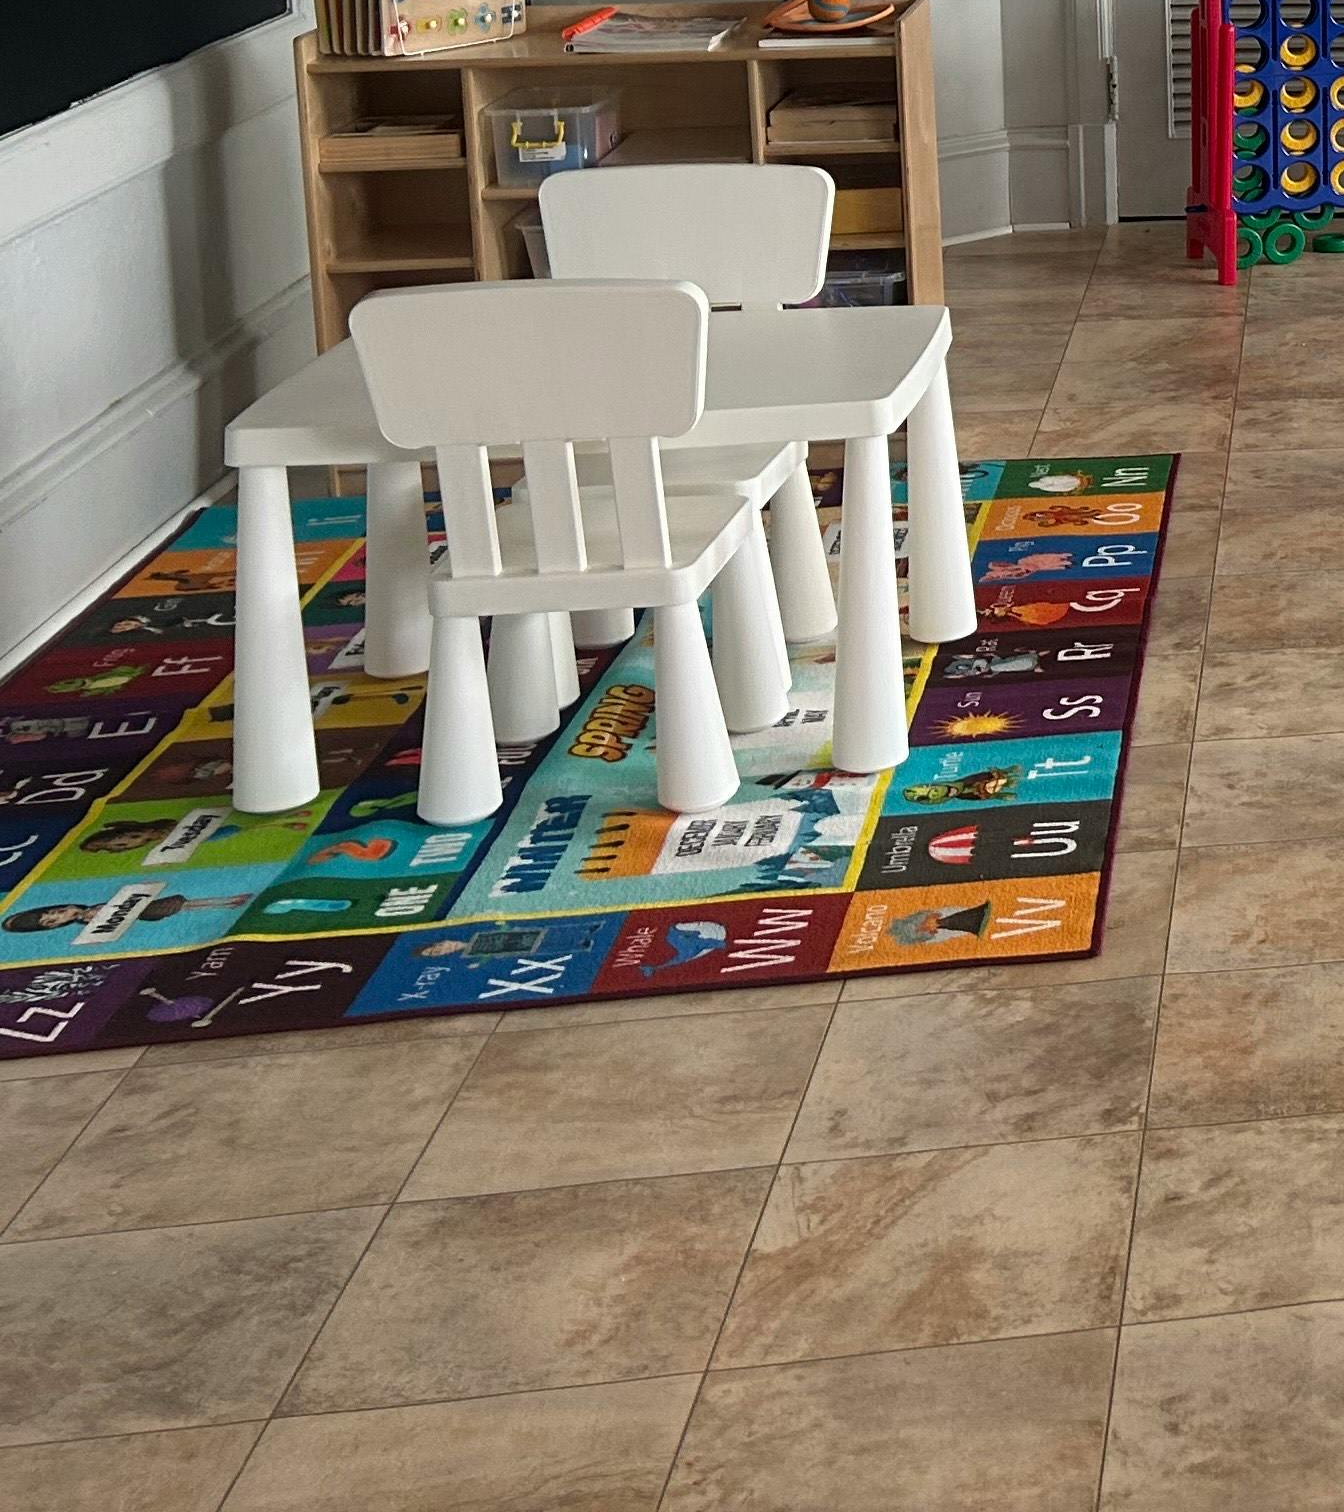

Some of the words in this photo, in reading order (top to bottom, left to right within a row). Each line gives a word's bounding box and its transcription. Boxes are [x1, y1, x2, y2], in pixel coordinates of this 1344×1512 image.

[1100, 466, 1150, 488] Nn
[1091, 502, 1143, 526] Oo
[1081, 544, 1148, 568] Pp
[152, 655, 223, 677] Ff
[1056, 641, 1114, 662] Rr
[957, 691, 983, 709] Sun
[1042, 694, 1104, 720] Ss
[567, 684, 656, 763] SPRING
[1027, 755, 1093, 779] Tt
[15, 768, 109, 806] Dd
[307, 838, 394, 866] 2
[408, 832, 473, 867] TWO
[489, 794, 593, 897] WINTER
[880, 825, 918, 874] Umbrella
[1010, 820, 1080, 859] Uu
[91, 893, 153, 935] Monday
[374, 884, 439, 917] ONE
[990, 896, 1067, 940] Vv
[613, 926, 657, 968] Whale
[720, 908, 814, 974] Ww
[847, 903, 889, 955] Volcano
[185, 947, 235, 981] Yarn
[478, 954, 574, 1000] Xx
[238, 959, 353, 1006] Yy
[397, 966, 451, 1002] X-ray
